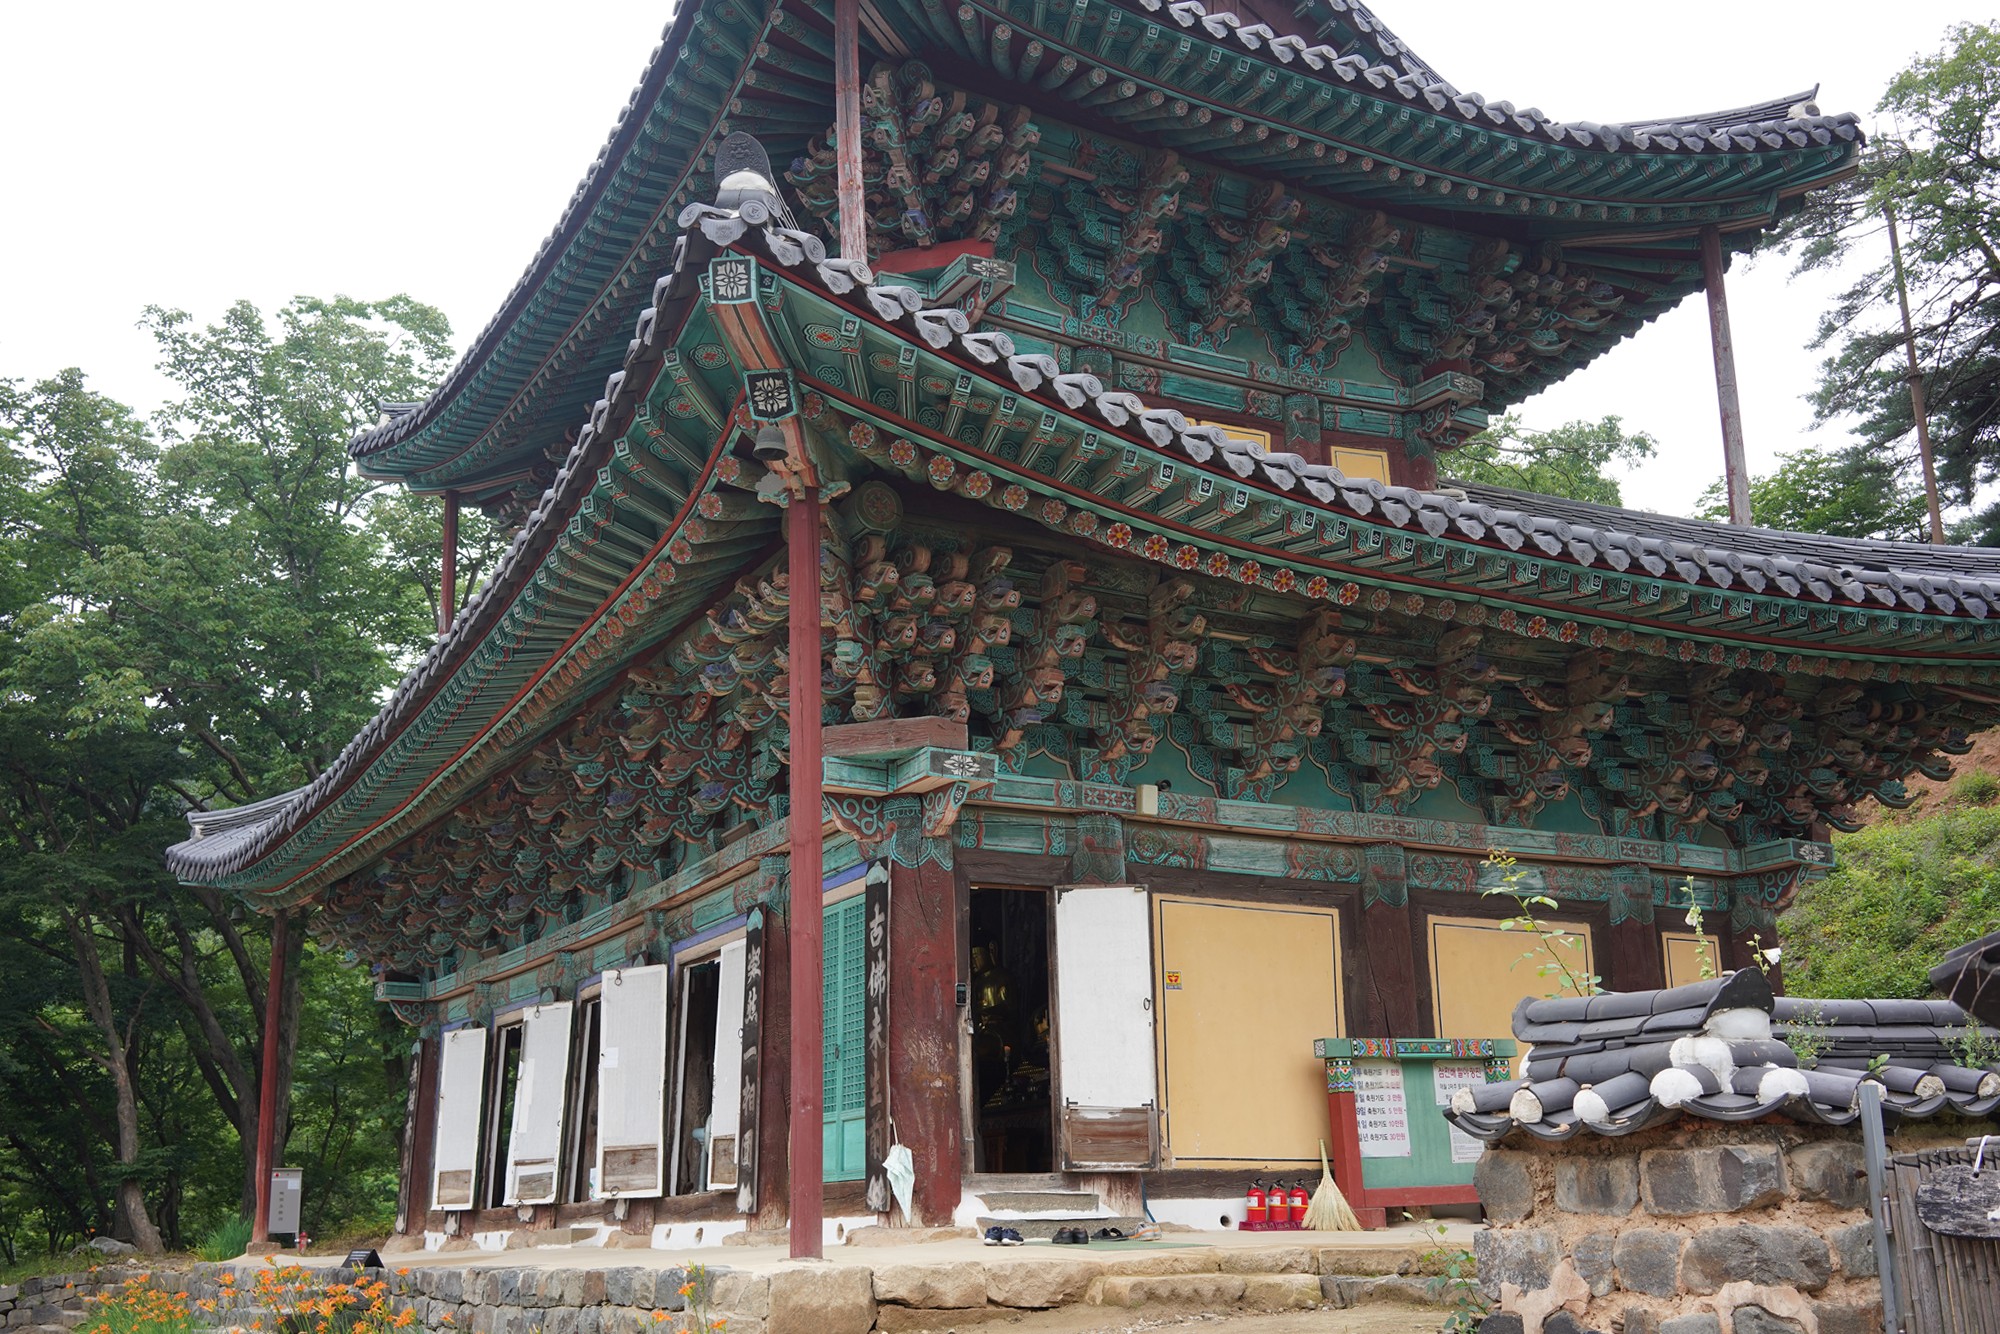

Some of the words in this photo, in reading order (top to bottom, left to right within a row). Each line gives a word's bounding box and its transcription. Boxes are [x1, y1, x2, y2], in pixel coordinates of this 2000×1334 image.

[1363, 1068, 1383, 1076] 축원기도
[1366, 1094, 1385, 1102] 축원기도
[1367, 1107, 1386, 1115] 축원기도
[1368, 1120, 1387, 1128] 축원기도
[1370, 1133, 1389, 1141] 축원기도
